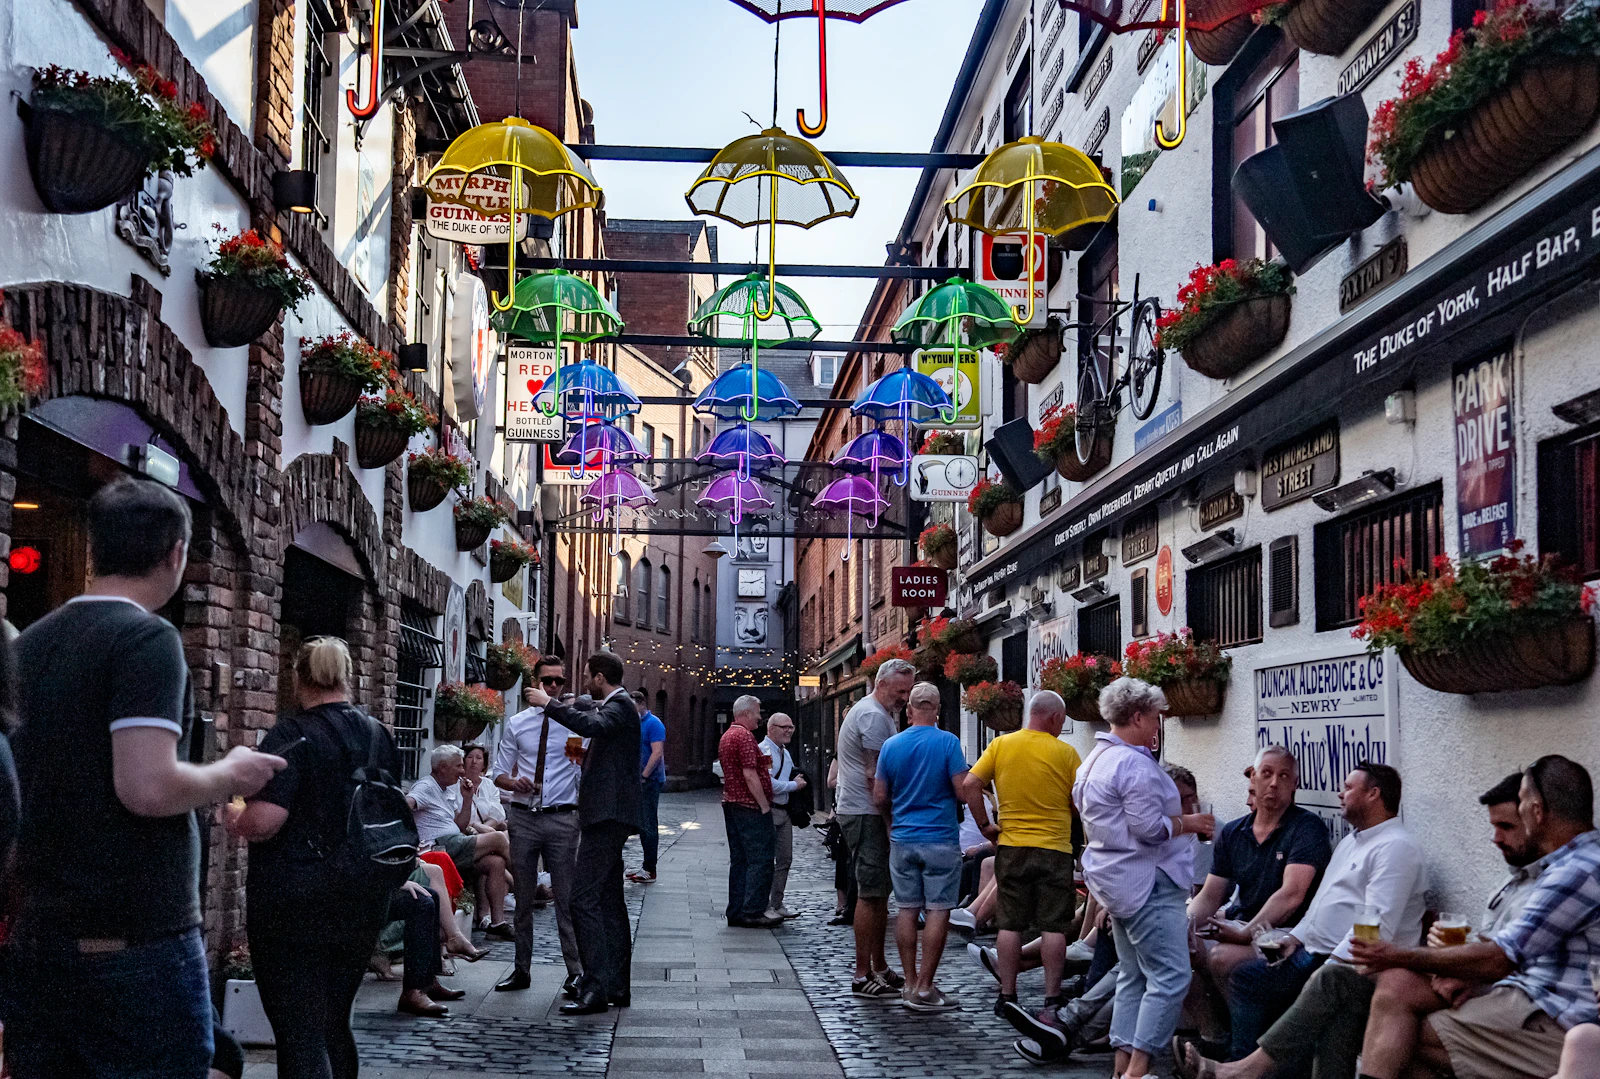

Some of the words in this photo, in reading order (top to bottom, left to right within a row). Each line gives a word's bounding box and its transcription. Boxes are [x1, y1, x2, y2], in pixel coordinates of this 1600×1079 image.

[1339, 24, 1394, 96] DUNRAVEN
[435, 177, 511, 193] MURPH
[432, 220, 449, 231] THE
[452, 222, 477, 234] DUKE
[479, 224, 492, 234] OF
[1340, 258, 1381, 309] PAXTON
[991, 287, 1045, 299] UINNESS
[1353, 344, 1378, 374] THE
[1379, 323, 1415, 361] DUKE
[1416, 311, 1436, 338] OF
[1437, 286, 1480, 326] YORK,
[1487, 251, 1533, 298] HALF
[1536, 226, 1581, 270] BAP,
[931, 354, 976, 364] YOUNERS
[519, 364, 552, 376] RED
[1455, 352, 1507, 417] PARK
[516, 417, 552, 426] BOTTLED
[507, 428, 560, 439] GUINNESS
[1458, 404, 1510, 466] DRIVE
[1181, 453, 1195, 474] AND
[1196, 441, 1214, 463] CALL
[1214, 425, 1239, 454] AGAIN
[552, 471, 601, 481] UINESS
[1276, 463, 1314, 498] STREET
[931, 488, 971, 497] GUINNES
[1481, 501, 1508, 525] BELFAST
[899, 576, 938, 584] LADIES
[902, 589, 936, 598] ROOM
[1261, 668, 1298, 699] DUNCAN,
[1299, 660, 1356, 696] ALDERDICE
[1358, 662, 1366, 691] &
[1291, 698, 1341, 714] NEWRY
